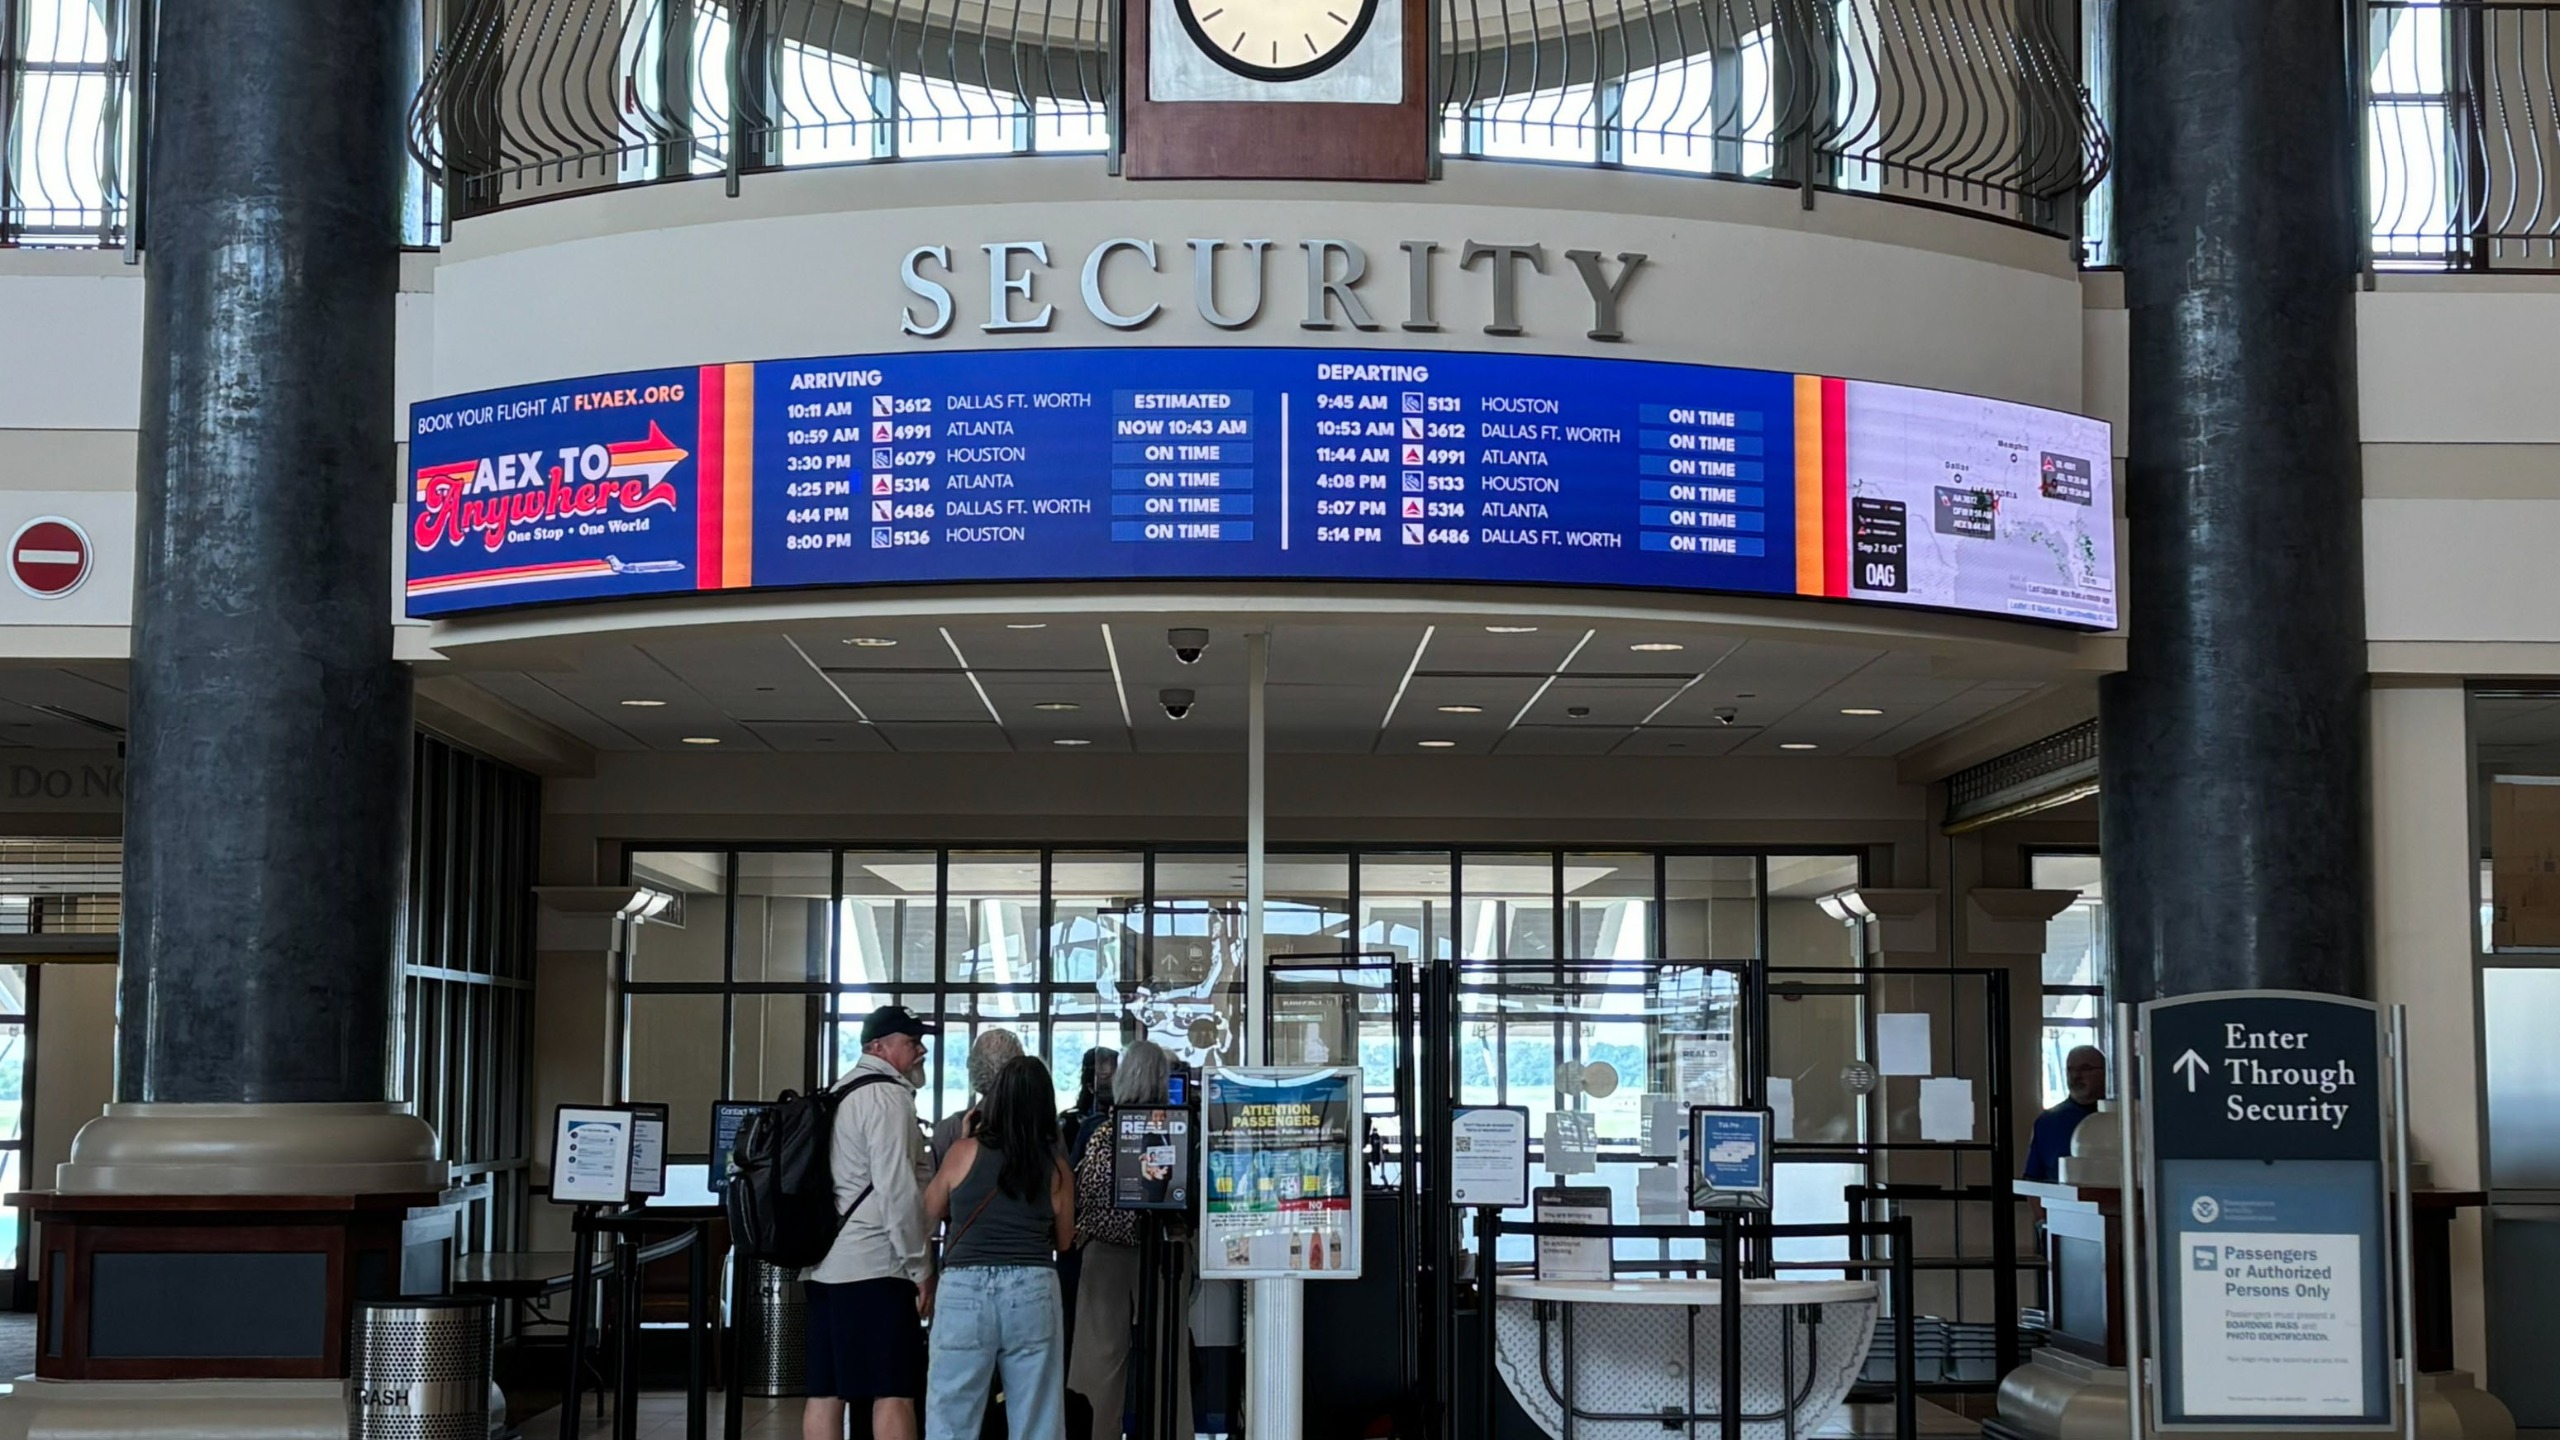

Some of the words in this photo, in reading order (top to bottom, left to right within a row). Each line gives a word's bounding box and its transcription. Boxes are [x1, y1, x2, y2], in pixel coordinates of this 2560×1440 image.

[901, 238, 1648, 342] SECURITY
[790, 370, 882, 390] ARRIVING
[1318, 364, 1428, 382] DEPARTING
[418, 417, 453, 434] BOOK
[457, 408, 493, 428] YOUR
[498, 399, 546, 421] FLIGHT
[551, 396, 570, 414] AT
[574, 385, 684, 411] FLYAEX.ORG
[788, 404, 821, 418] 10:11
[825, 402, 851, 416] AM
[895, 398, 931, 413] 3612
[948, 394, 1003, 410] DALLAS
[1008, 394, 1028, 408] FT.
[1033, 393, 1090, 407] WORTH
[1135, 394, 1230, 408] ESTIMATED
[1317, 394, 1354, 409] 9:45
[1358, 395, 1387, 409] AM
[1428, 397, 1460, 411] 5131
[1482, 397, 1558, 414] HOUSTON
[1669, 409, 1695, 424] ON
[1698, 411, 1734, 427] TIME
[788, 429, 828, 444] 10:59
[832, 428, 859, 442] AM
[895, 425, 931, 439] 4991
[947, 421, 1014, 436] ATLANTA
[1118, 420, 1163, 434] NOW
[1169, 420, 1213, 434] 10:43
[1217, 420, 1246, 434] AM
[1317, 421, 1361, 435] 10:53
[1366, 422, 1394, 436] AM
[1428, 423, 1465, 438] 3612
[1482, 423, 1537, 439] DALLAS
[1541, 426, 1561, 440] FT.
[1566, 427, 1620, 443] WORTH
[1670, 434, 1695, 449] ON
[1699, 436, 1735, 452] TIME
[472, 451, 543, 493] AEX
[560, 445, 610, 482] TO
[788, 456, 822, 471] 3:30
[826, 454, 850, 469] PM
[895, 451, 935, 465] 6079
[948, 447, 1025, 462] HOUSTON
[1145, 446, 1173, 460] ON
[1178, 446, 1219, 460] TIME
[1317, 448, 1356, 461] 11:44
[1360, 448, 1389, 462] AM
[1427, 450, 1465, 464] 4991
[1482, 450, 1548, 465] ATLANTA
[1670, 459, 1695, 474] ON
[1699, 461, 1735, 477] TIME
[1945, 461, 1969, 471] Dallas
[787, 482, 821, 496] 4:25
[825, 481, 849, 495] PM
[895, 478, 930, 492] 5314
[947, 474, 1013, 489] ATLANTA
[1145, 473, 1173, 487] ON
[1178, 473, 1219, 486] TIME
[1317, 474, 1355, 488] 4:08
[1360, 475, 1386, 489] PM
[1428, 476, 1464, 490] 5133
[1482, 476, 1558, 492] HOUSTON
[1670, 485, 1695, 500] ON
[1699, 487, 1735, 503] TIME
[414, 466, 676, 552] Anywhere
[787, 508, 820, 523] 4:44
[824, 507, 848, 521] PM
[894, 504, 934, 519] 6486
[947, 500, 1003, 515] DALLAS
[1007, 500, 1027, 514] FT.
[1033, 499, 1090, 513] WORTH
[1145, 498, 1173, 512] ON
[1178, 498, 1219, 512] TIME
[1318, 501, 1355, 514] 5:07
[1360, 501, 1386, 515] PM
[1428, 503, 1464, 517] 5314
[1482, 502, 1548, 518] ATLANTA
[1670, 511, 1696, 525] ON
[1699, 512, 1736, 528] TIME
[508, 529, 531, 542] One
[534, 527, 563, 541] Stop
[579, 522, 604, 537] One
[608, 518, 649, 532] World
[787, 535, 822, 549] 8:00
[826, 533, 851, 547] PM
[894, 530, 930, 545] 5136
[947, 527, 1024, 542] HOUSTON
[1145, 524, 1173, 538] ON
[1178, 524, 1219, 538] TIME
[1318, 527, 1350, 541] 5:14
[1354, 528, 1381, 541] PM
[1428, 529, 1469, 543] 6486
[1482, 529, 1538, 544] DALLAS
[1542, 530, 1561, 545] FT.
[1567, 532, 1621, 547] WORTH
[1670, 536, 1696, 551] ON
[1699, 537, 1736, 553] TIME
[1858, 542, 1873, 553] Sep
[1866, 563, 1895, 586] OAG
[2225, 1023, 2308, 1049] Enter
[2224, 1058, 2356, 1093] Through
[721, 1107, 747, 1116] Contact
[1241, 1104, 1311, 1115] ATTENTION
[2227, 1095, 2349, 1129] Security
[1121, 1121, 1167, 1134] REAL
[1170, 1122, 1186, 1134] ID
[1232, 1116, 1320, 1128] PASSENGERS
[1308, 1202, 1322, 1210] NO
[2225, 1246, 2318, 1263] Passengers
[2226, 1268, 2240, 1278] or
[2247, 1265, 2331, 1279] Authorized
[2226, 1283, 2289, 1297] Persons
[2296, 1284, 2330, 1300] Only
[2226, 1321, 2273, 1329] BOARDING
